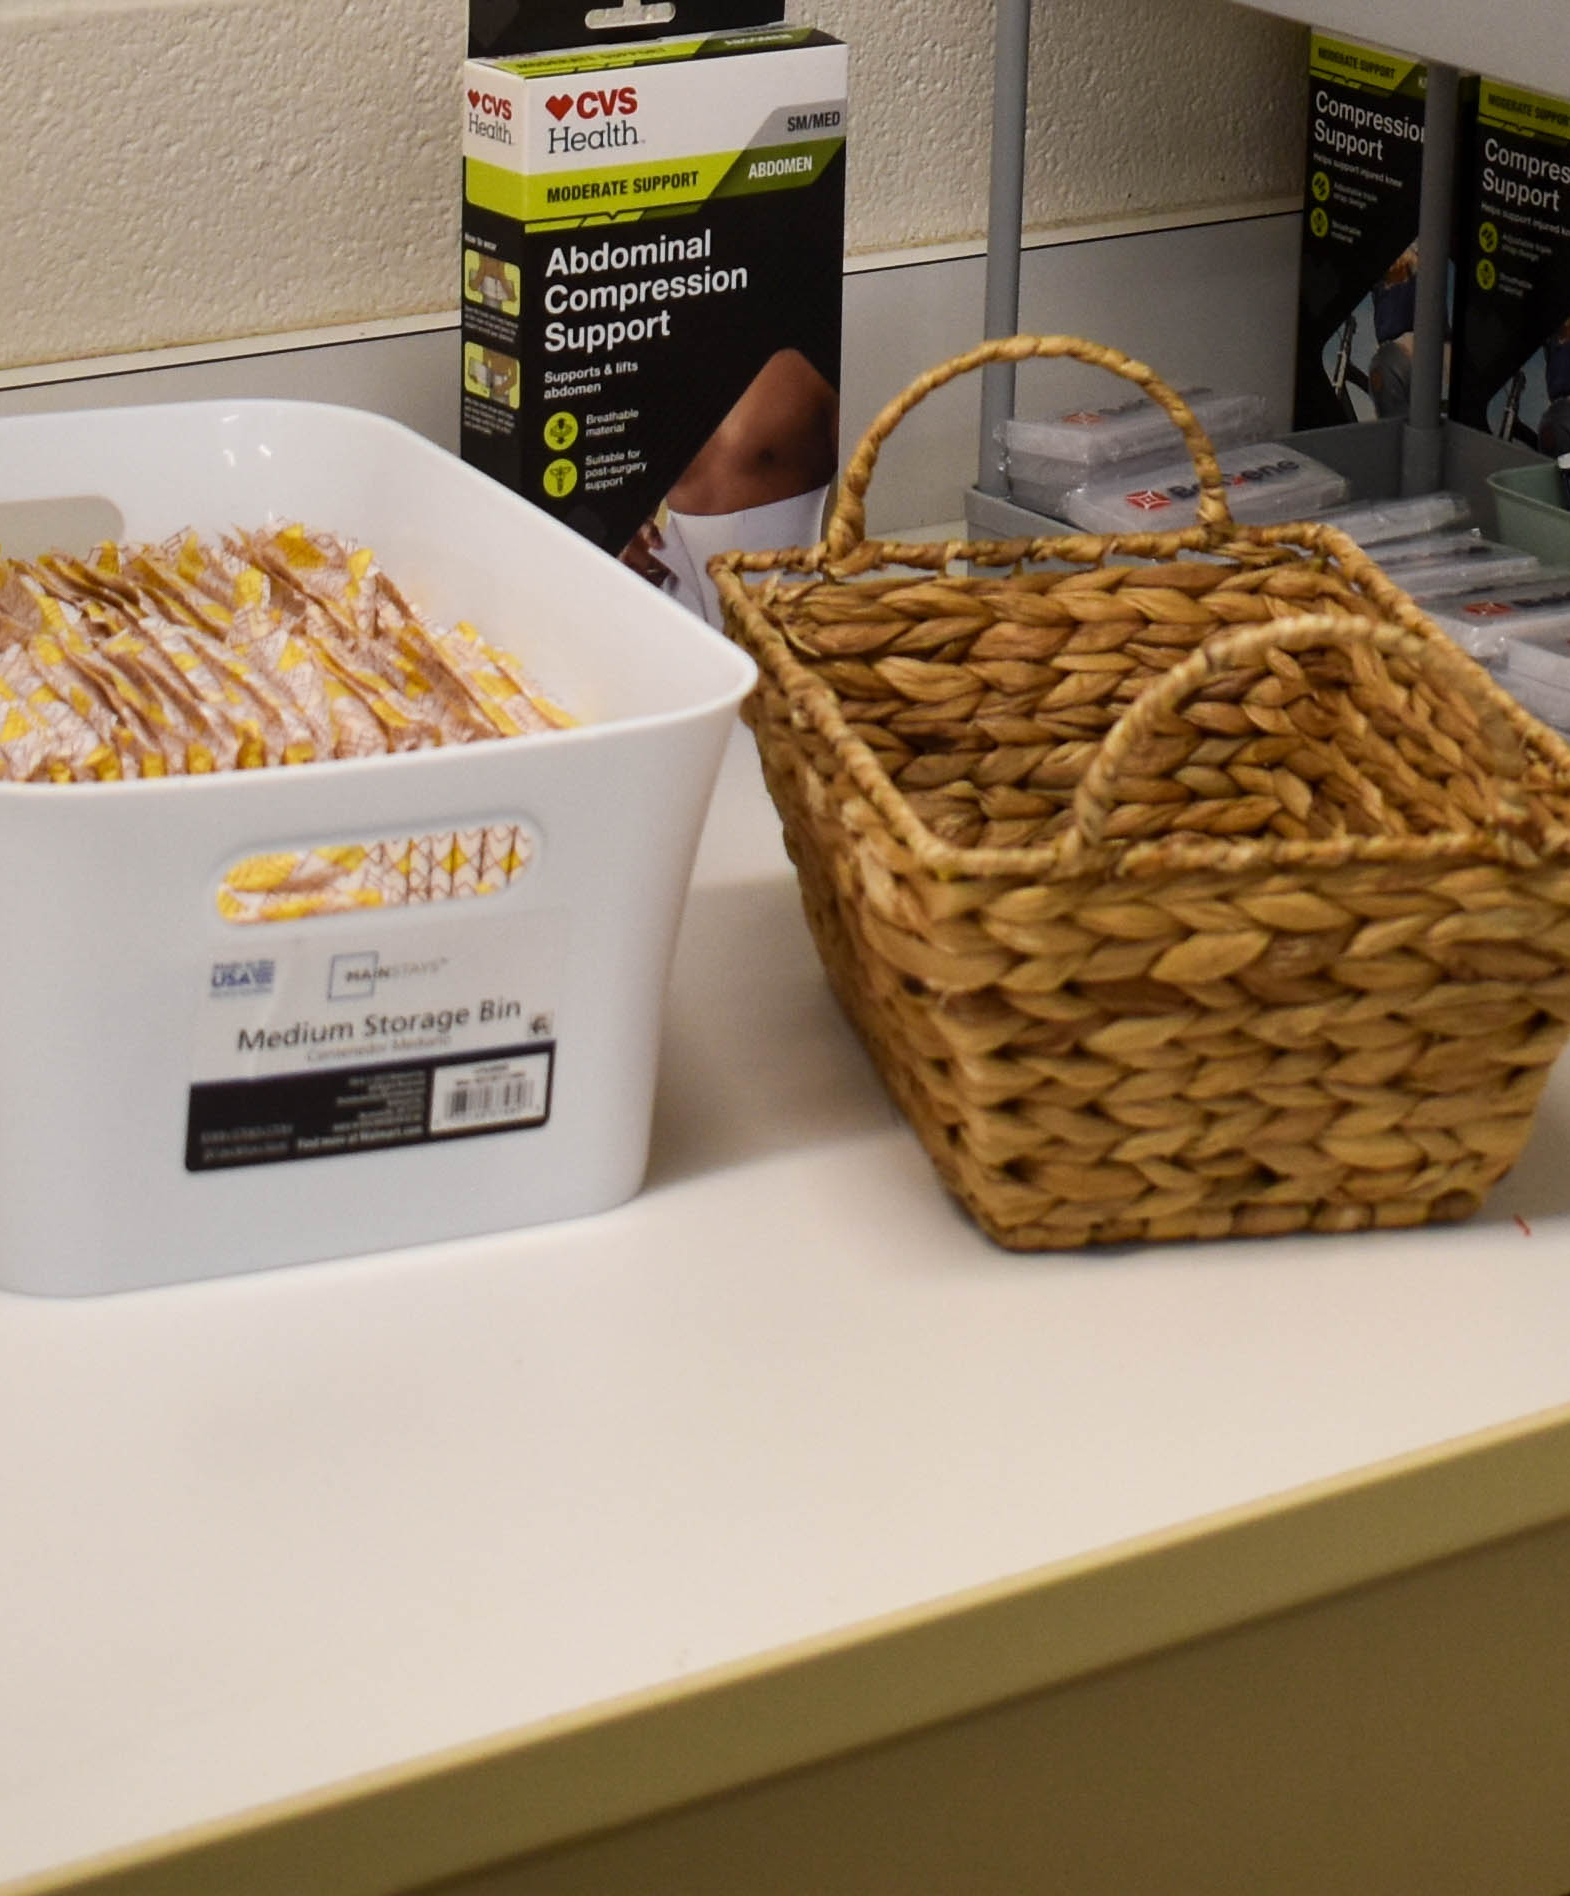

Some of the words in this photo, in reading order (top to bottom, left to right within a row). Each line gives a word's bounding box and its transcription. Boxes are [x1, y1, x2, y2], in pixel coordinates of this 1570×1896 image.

[1360, 59, 1395, 81] SUPPORT
[481, 94, 512, 121] CVS
[575, 86, 639, 120] CVS
[467, 112, 512, 146] Health
[787, 110, 841, 132] SM/MED
[547, 120, 639, 154] Health
[1314, 118, 1383, 161] Support
[748, 155, 813, 180] ABDOMEN
[547, 176, 628, 203] MODERATE
[632, 170, 699, 194] SUPPORT
[1482, 167, 1560, 212] Support
[545, 228, 712, 278] Abdominal
[544, 265, 748, 315] Compression
[544, 309, 672, 354] Support
[544, 365, 600, 384] Supports
[604, 364, 613, 376] &
[616, 361, 639, 374] lifts
[544, 381, 601, 400] abdomen
[586, 408, 639, 425] Breathable
[585, 423, 625, 438] material
[585, 450, 625, 467] Suitable
[627, 448, 641, 459] for
[585, 460, 648, 481] post-surgery
[585, 474, 624, 492] support
[211, 966, 250, 989] USA
[237, 1020, 354, 1052] Medium
[364, 1006, 470, 1039] Storage
[479, 997, 522, 1023] Bin
